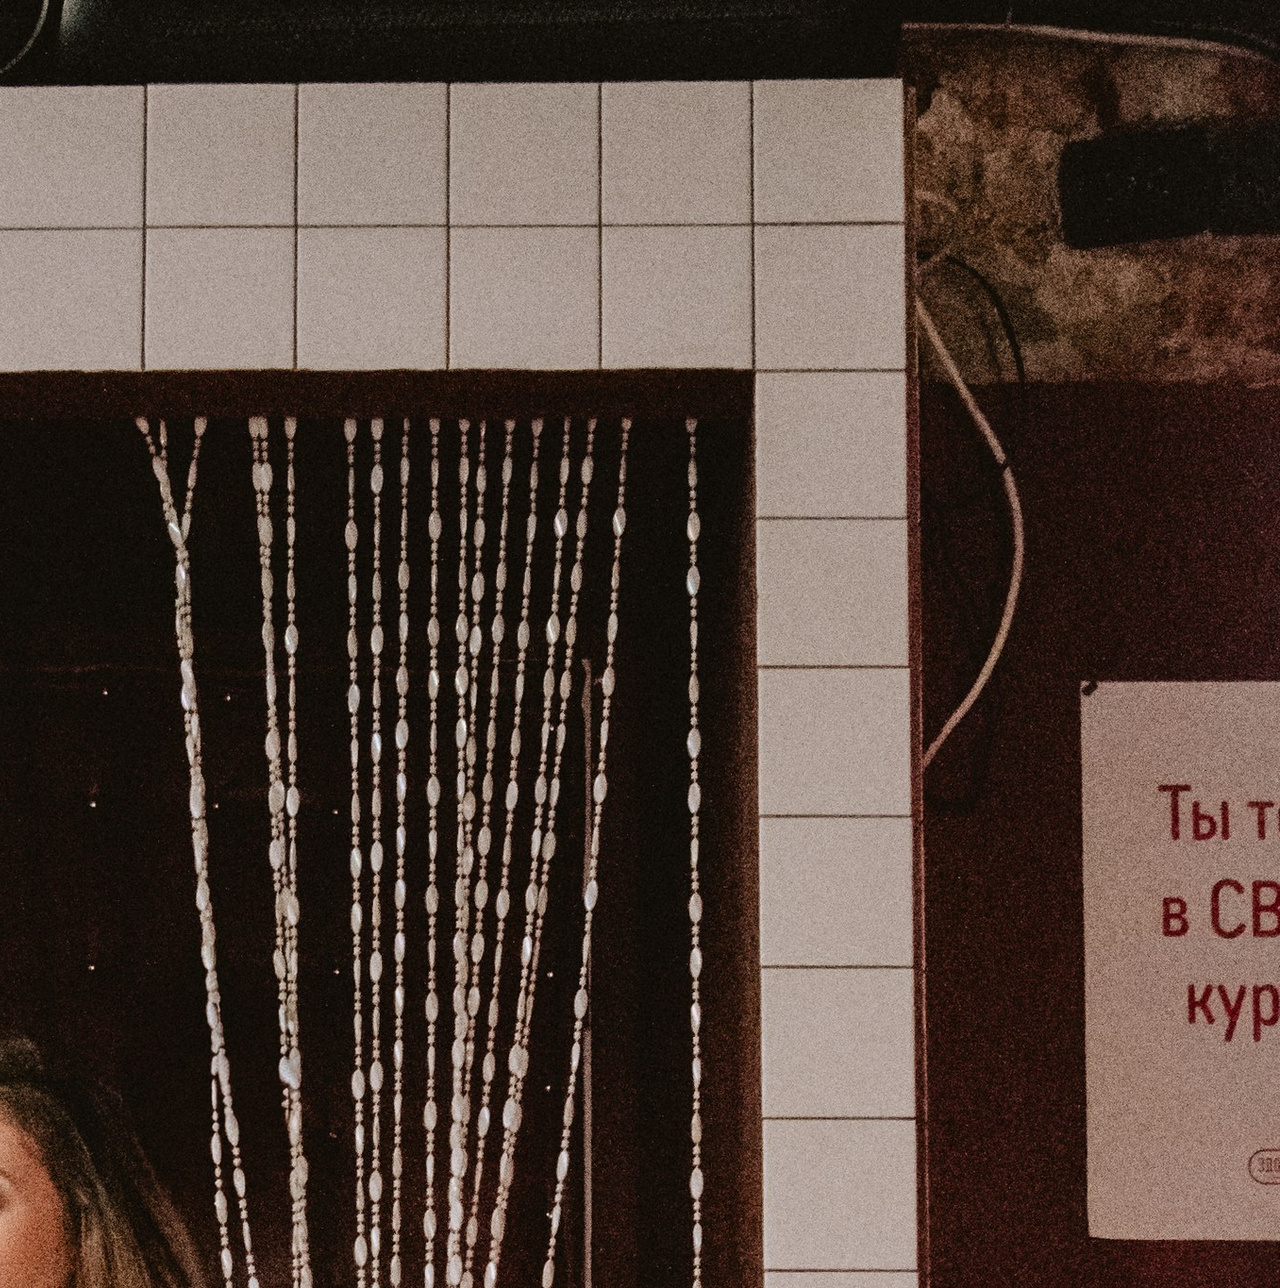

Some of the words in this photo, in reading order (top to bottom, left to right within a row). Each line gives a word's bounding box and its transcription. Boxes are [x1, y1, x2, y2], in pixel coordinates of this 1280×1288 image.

[1158, 784, 1230, 841] Ты
[1247, 801, 1280, 841] т
[1162, 897, 1189, 937] в
[1210, 878, 1280, 939] СВ
[1187, 984, 1280, 1042] кур
